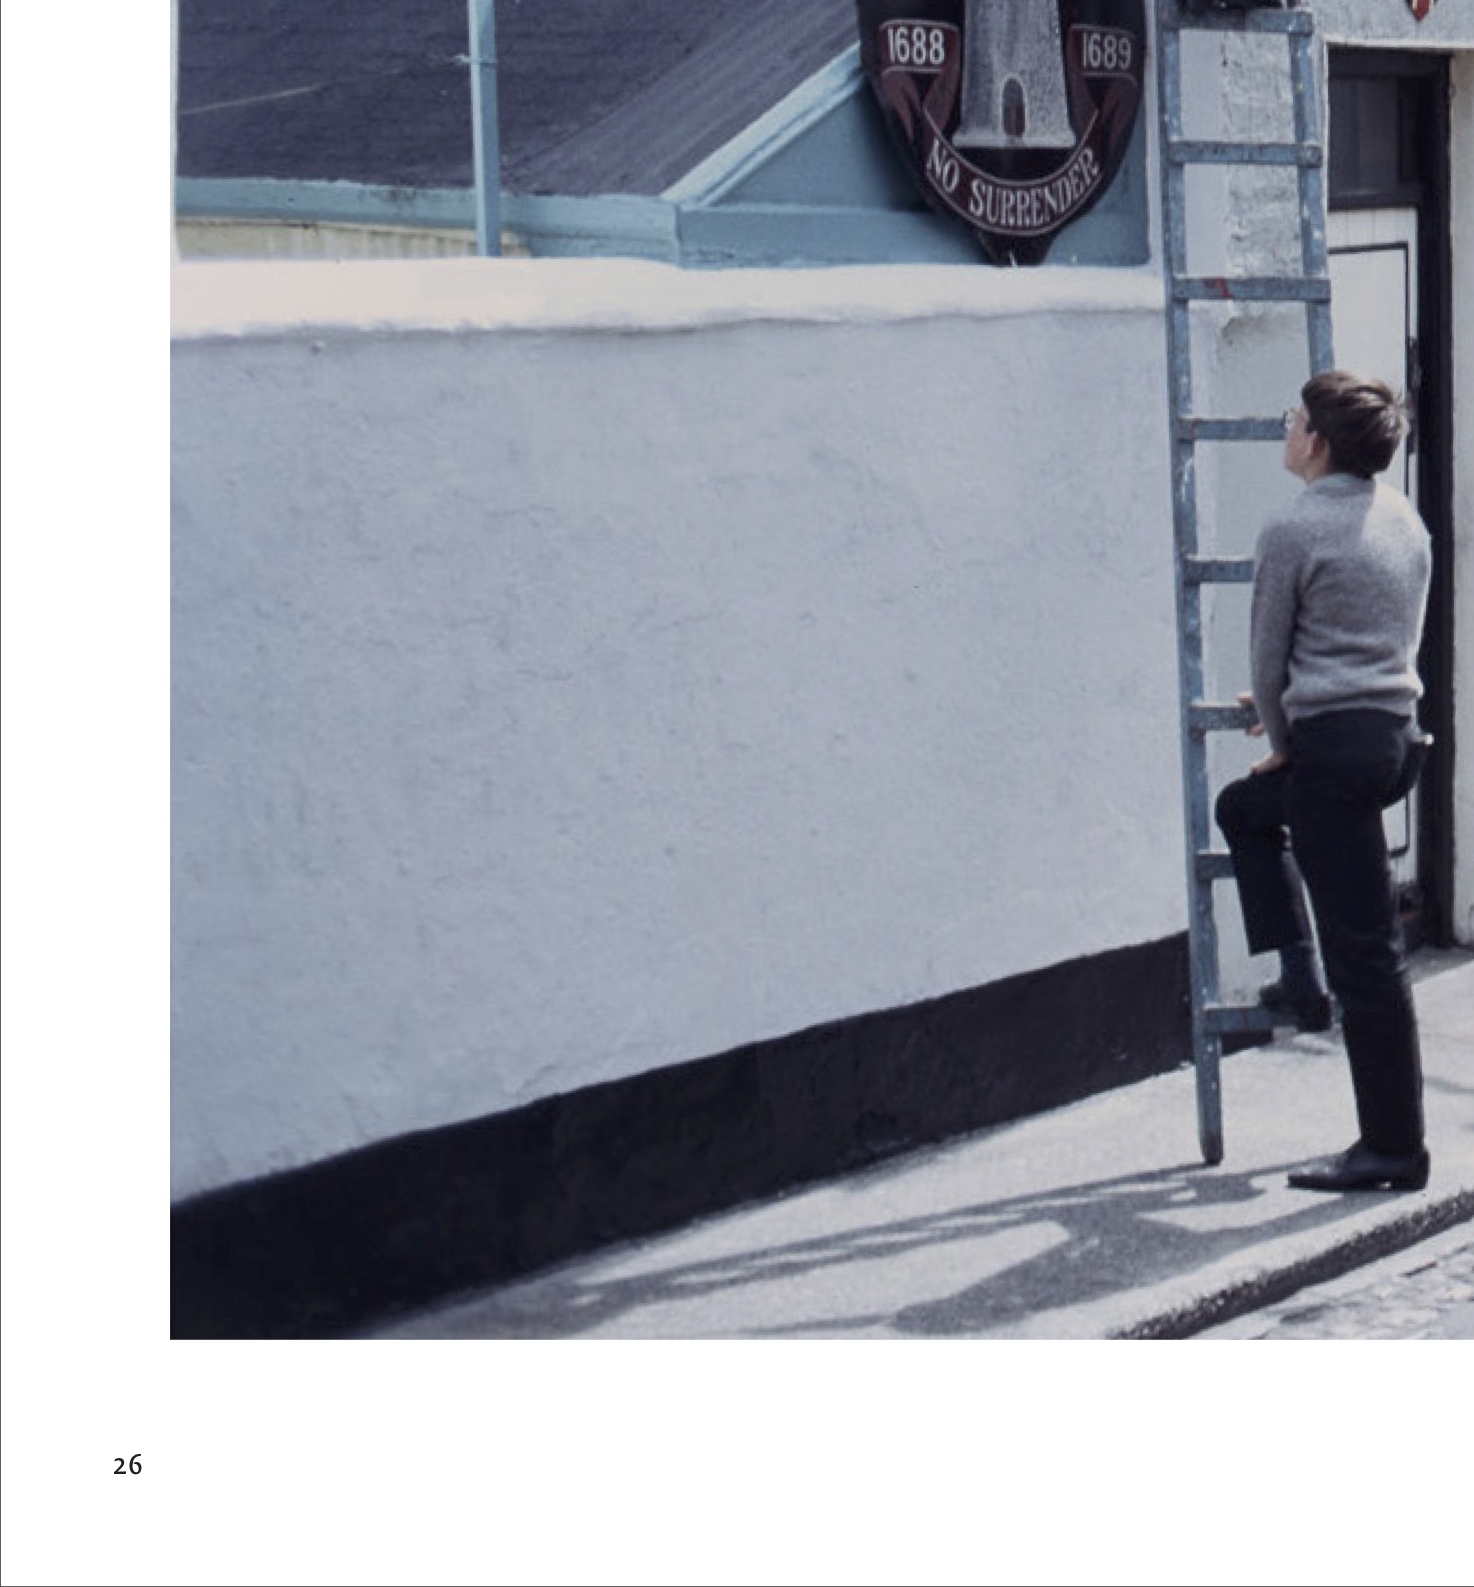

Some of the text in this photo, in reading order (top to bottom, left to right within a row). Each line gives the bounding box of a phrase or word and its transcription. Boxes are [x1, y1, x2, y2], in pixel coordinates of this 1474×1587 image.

[887, 26, 945, 65] 1688
[1081, 31, 1133, 70] 1689
[926, 137, 1099, 228] NO SURRENDER
